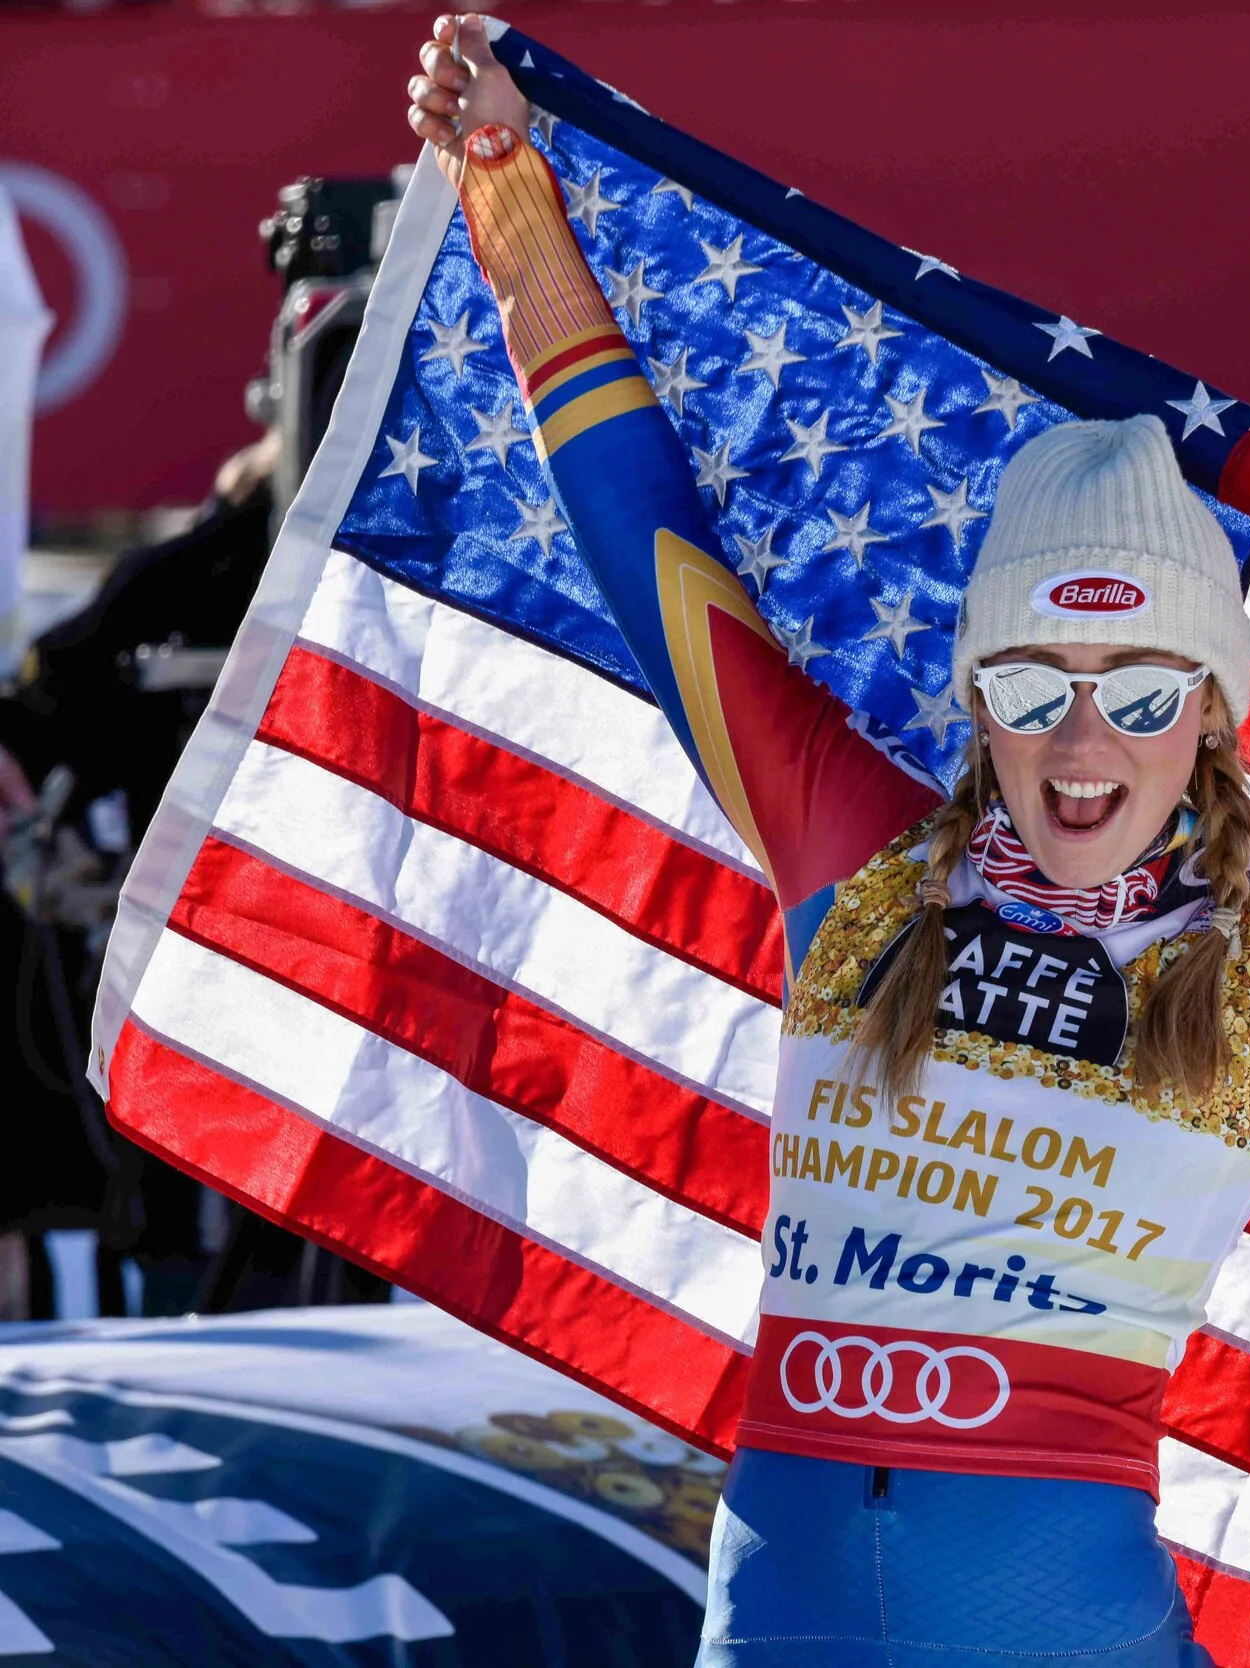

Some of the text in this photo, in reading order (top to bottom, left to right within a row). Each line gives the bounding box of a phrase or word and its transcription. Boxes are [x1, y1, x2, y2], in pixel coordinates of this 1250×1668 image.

[1059, 584, 1138, 605] Barilla
[1000, 905, 1057, 931] Emmi
[944, 927, 1103, 1004] AFFÈ
[937, 978, 1088, 1048] ATTE
[808, 1079, 1116, 1188] FIS SLALOM
[773, 1132, 1166, 1261] CHAMPION 2017
[770, 1215, 818, 1285] St.
